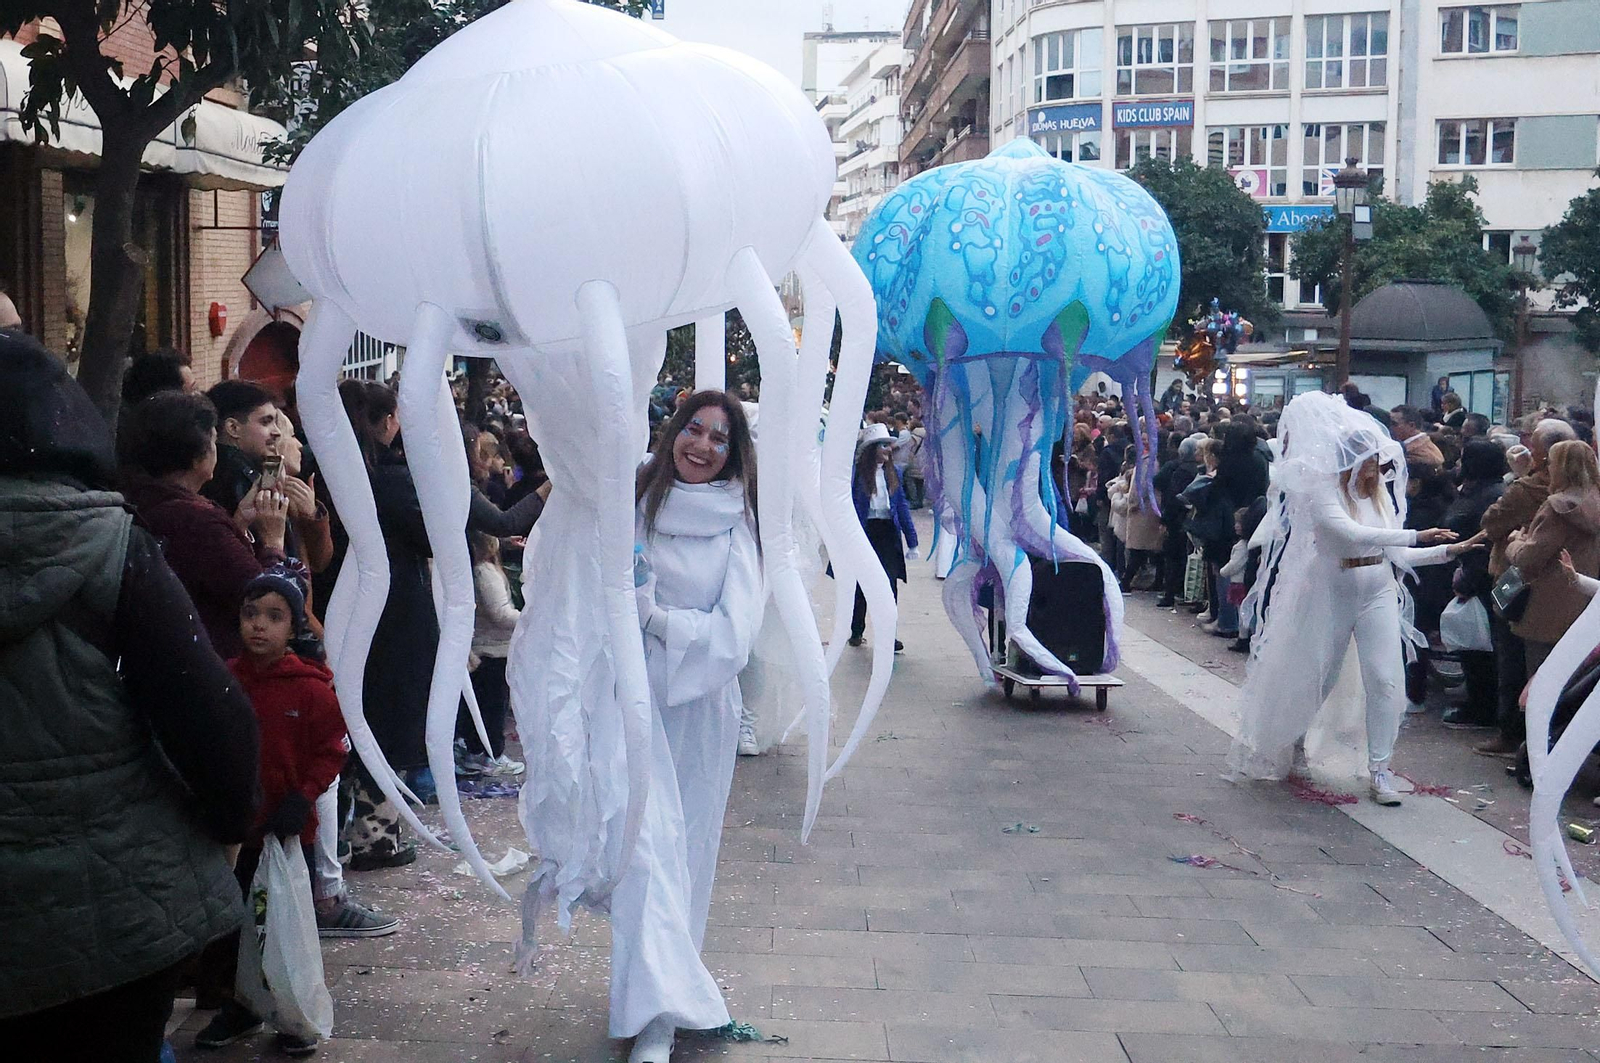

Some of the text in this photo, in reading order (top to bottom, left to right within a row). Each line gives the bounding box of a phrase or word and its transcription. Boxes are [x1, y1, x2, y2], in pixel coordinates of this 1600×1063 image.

[1117, 106, 1190, 123] KIDS CLUB SPAIN
[1060, 116, 1096, 130] HUELVA
